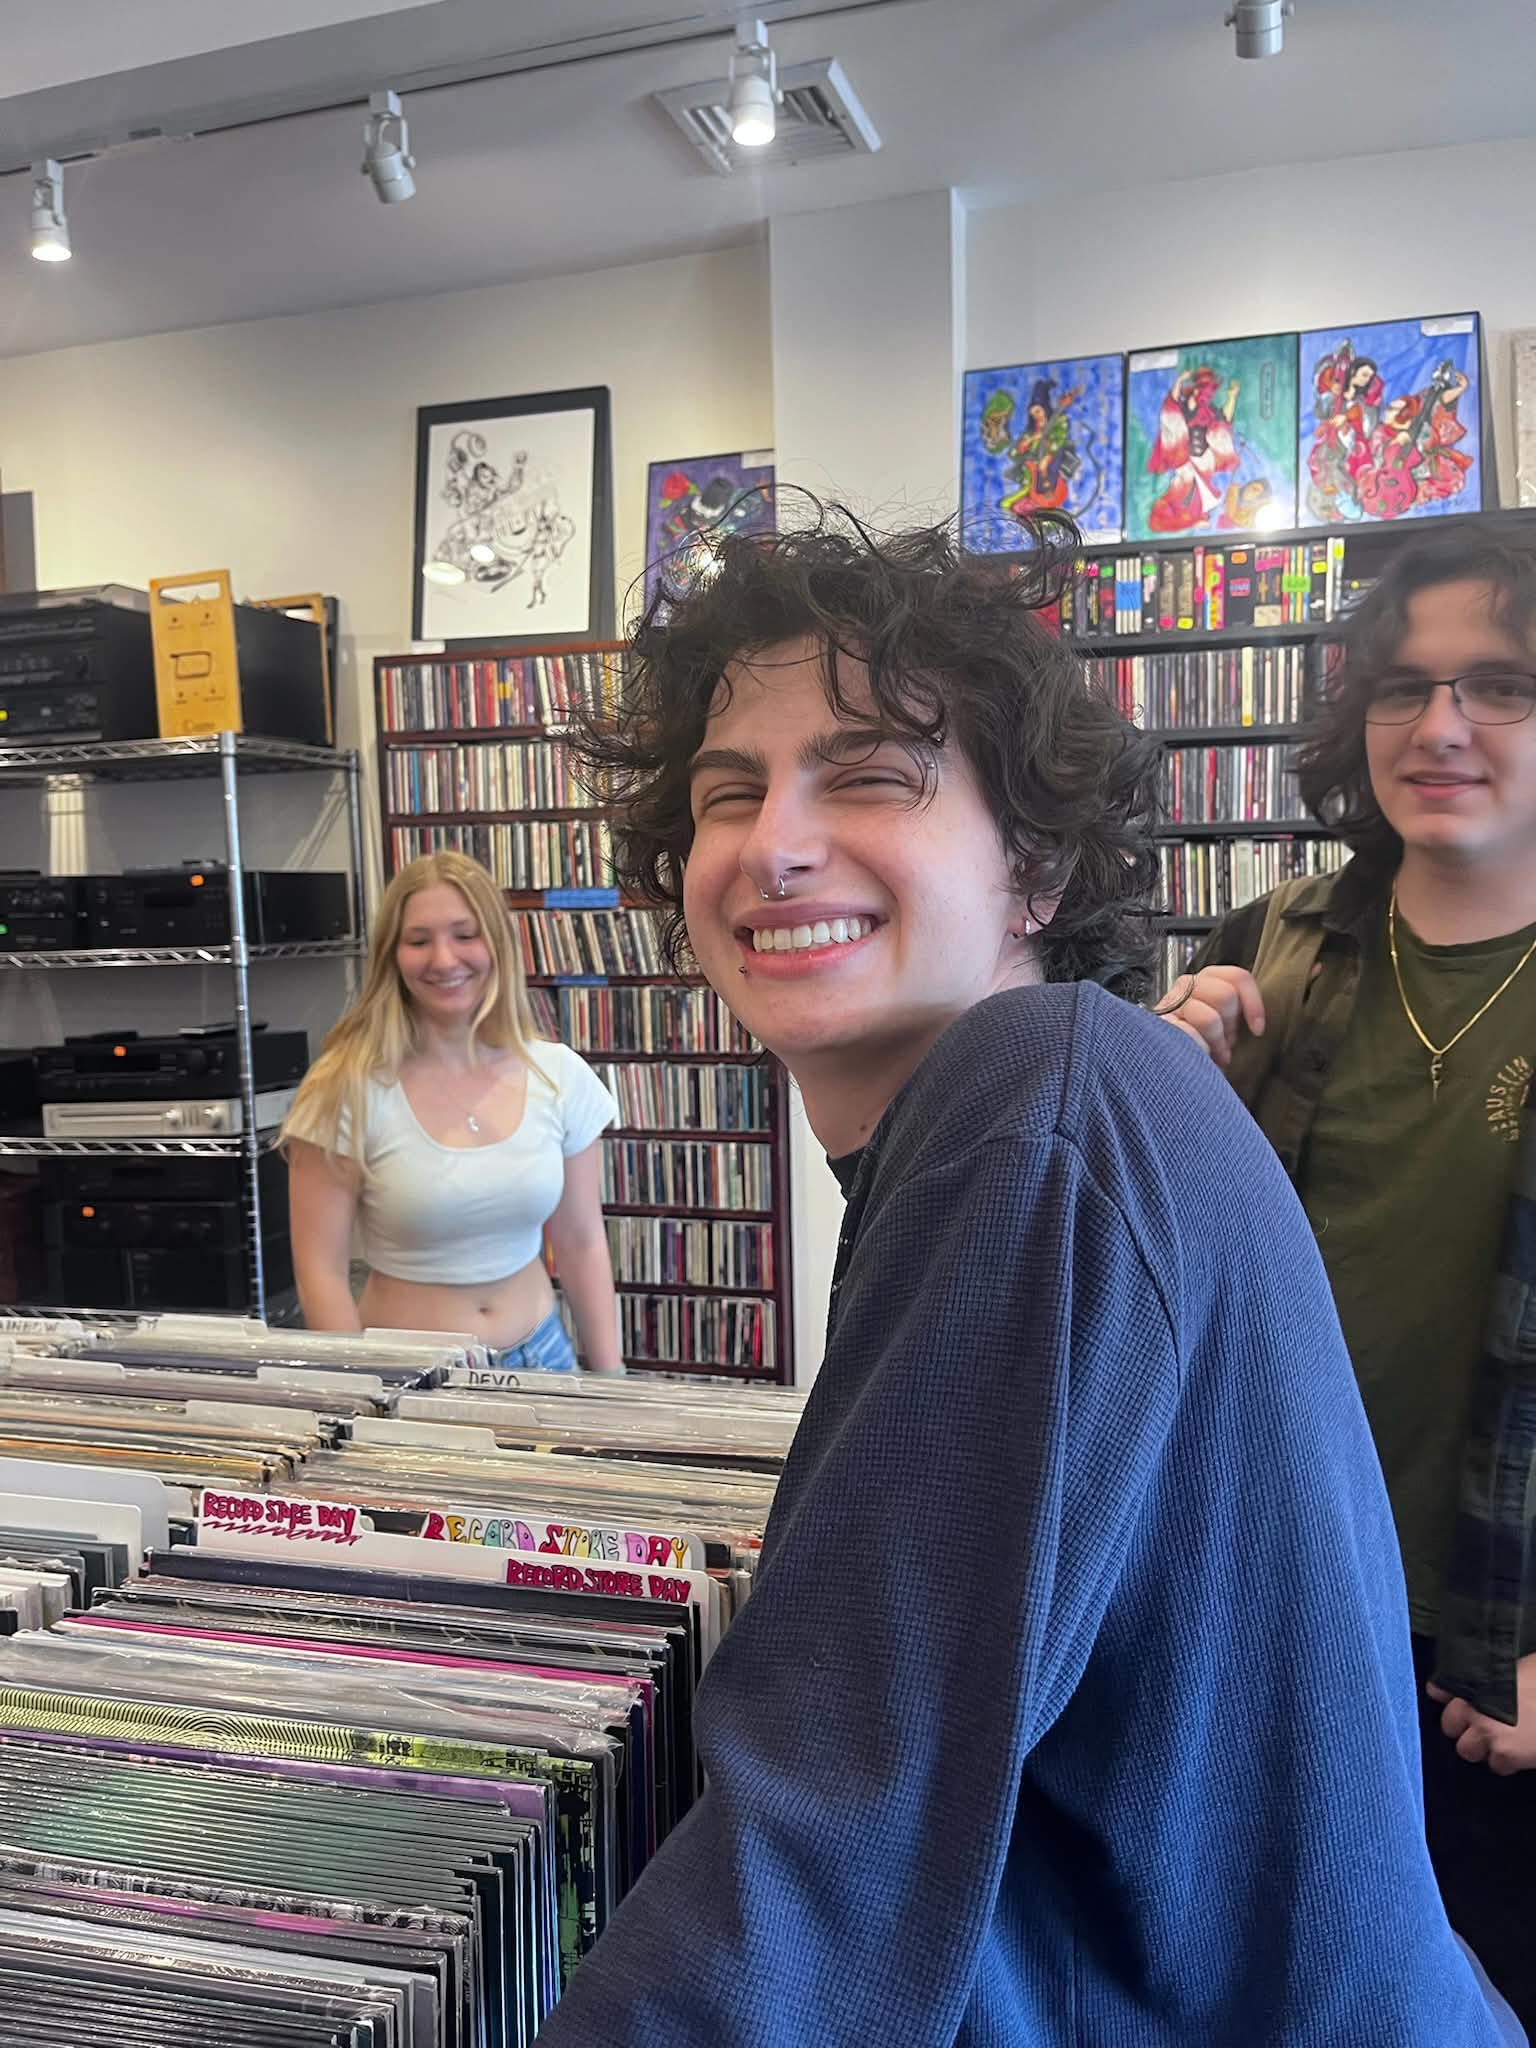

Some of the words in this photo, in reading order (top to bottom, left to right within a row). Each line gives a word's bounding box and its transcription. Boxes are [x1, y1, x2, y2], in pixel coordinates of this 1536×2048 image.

[468, 1370, 521, 1387] DEVO
[204, 1492, 264, 1522] RECORD
[265, 1500, 312, 1530] STORE
[317, 1505, 356, 1536] DAY
[422, 1512, 536, 1551] RECORD
[538, 1523, 620, 1562] STORE
[624, 1532, 689, 1569] DAY
[506, 1558, 584, 1592] RECORD
[584, 1567, 644, 1596] STORE
[648, 1574, 691, 1604] DAY
